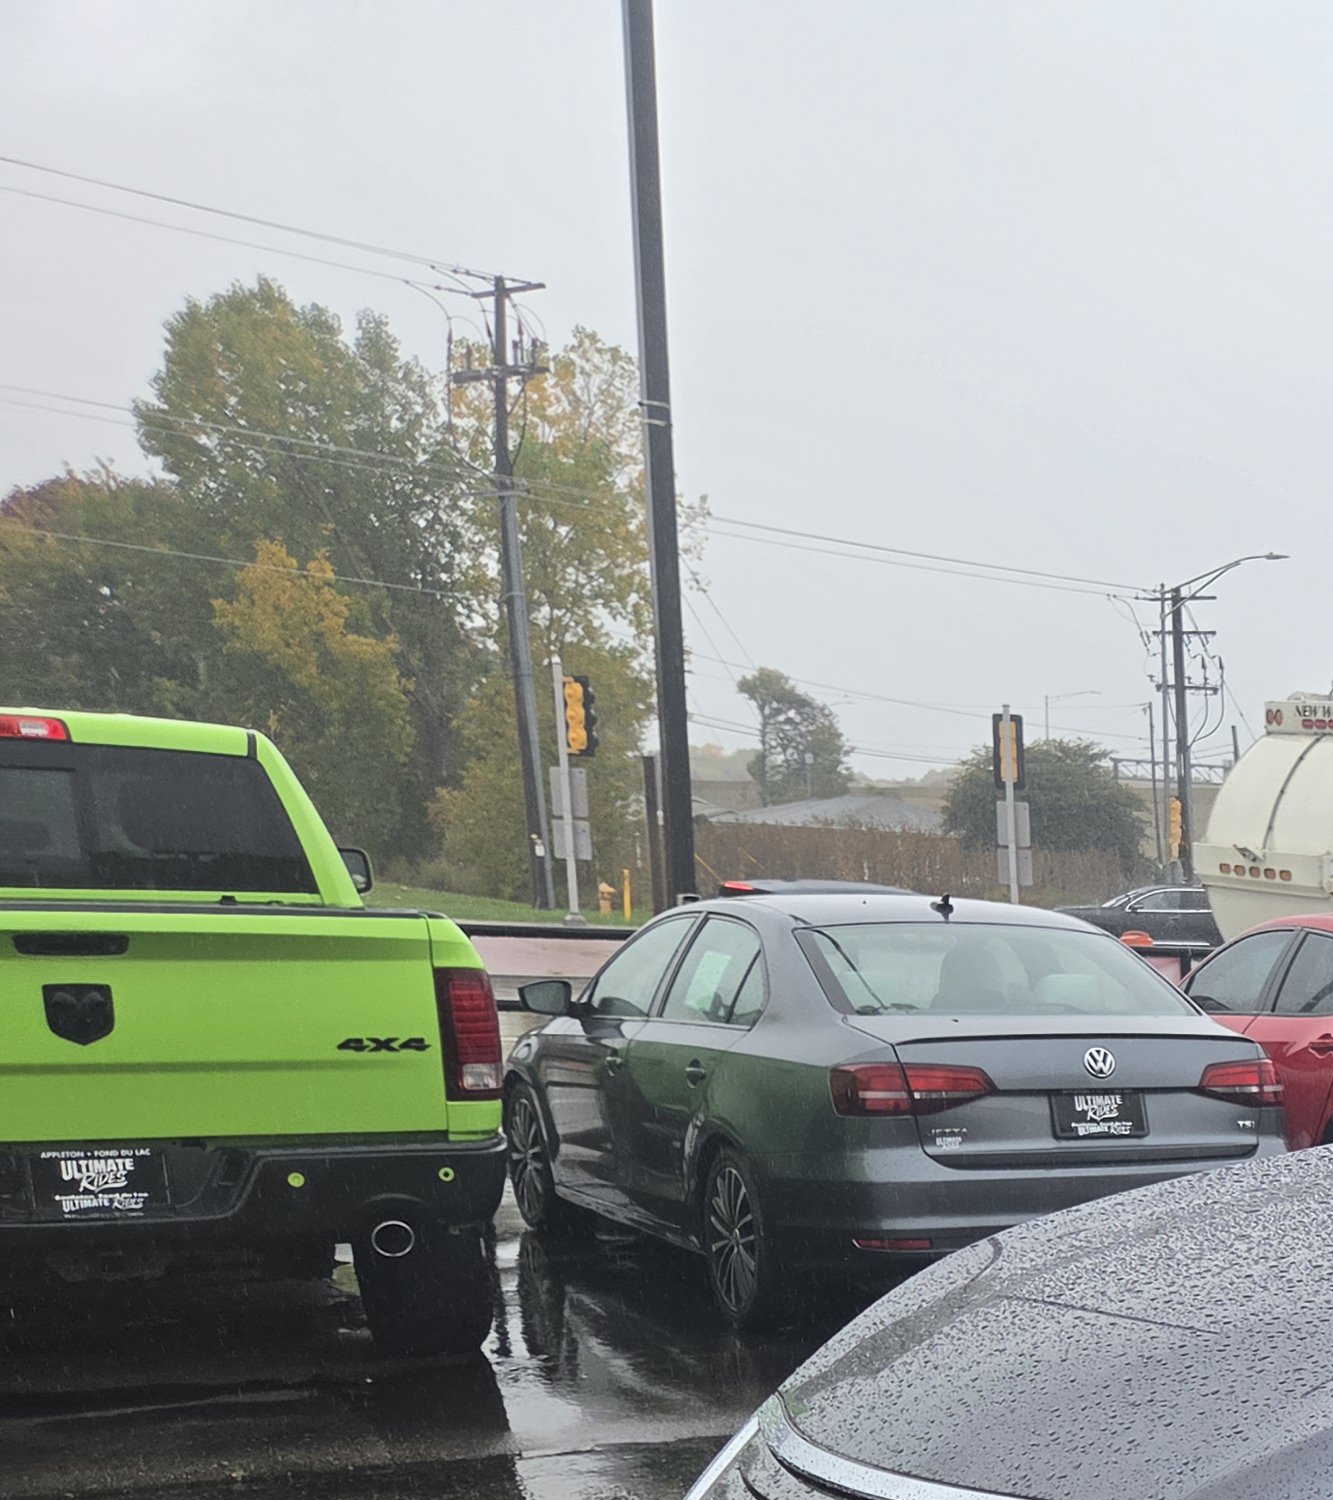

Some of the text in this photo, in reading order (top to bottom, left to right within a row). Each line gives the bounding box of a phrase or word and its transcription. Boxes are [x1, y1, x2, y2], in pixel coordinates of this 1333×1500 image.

[1074, 1094, 1123, 1111] ULTIMATE
[40, 1151, 85, 1159] APPLETON
[135, 1148, 151, 1156] LAC
[60, 1159, 135, 1181] ULTIMATE
[78, 1171, 128, 1193] RIDES
